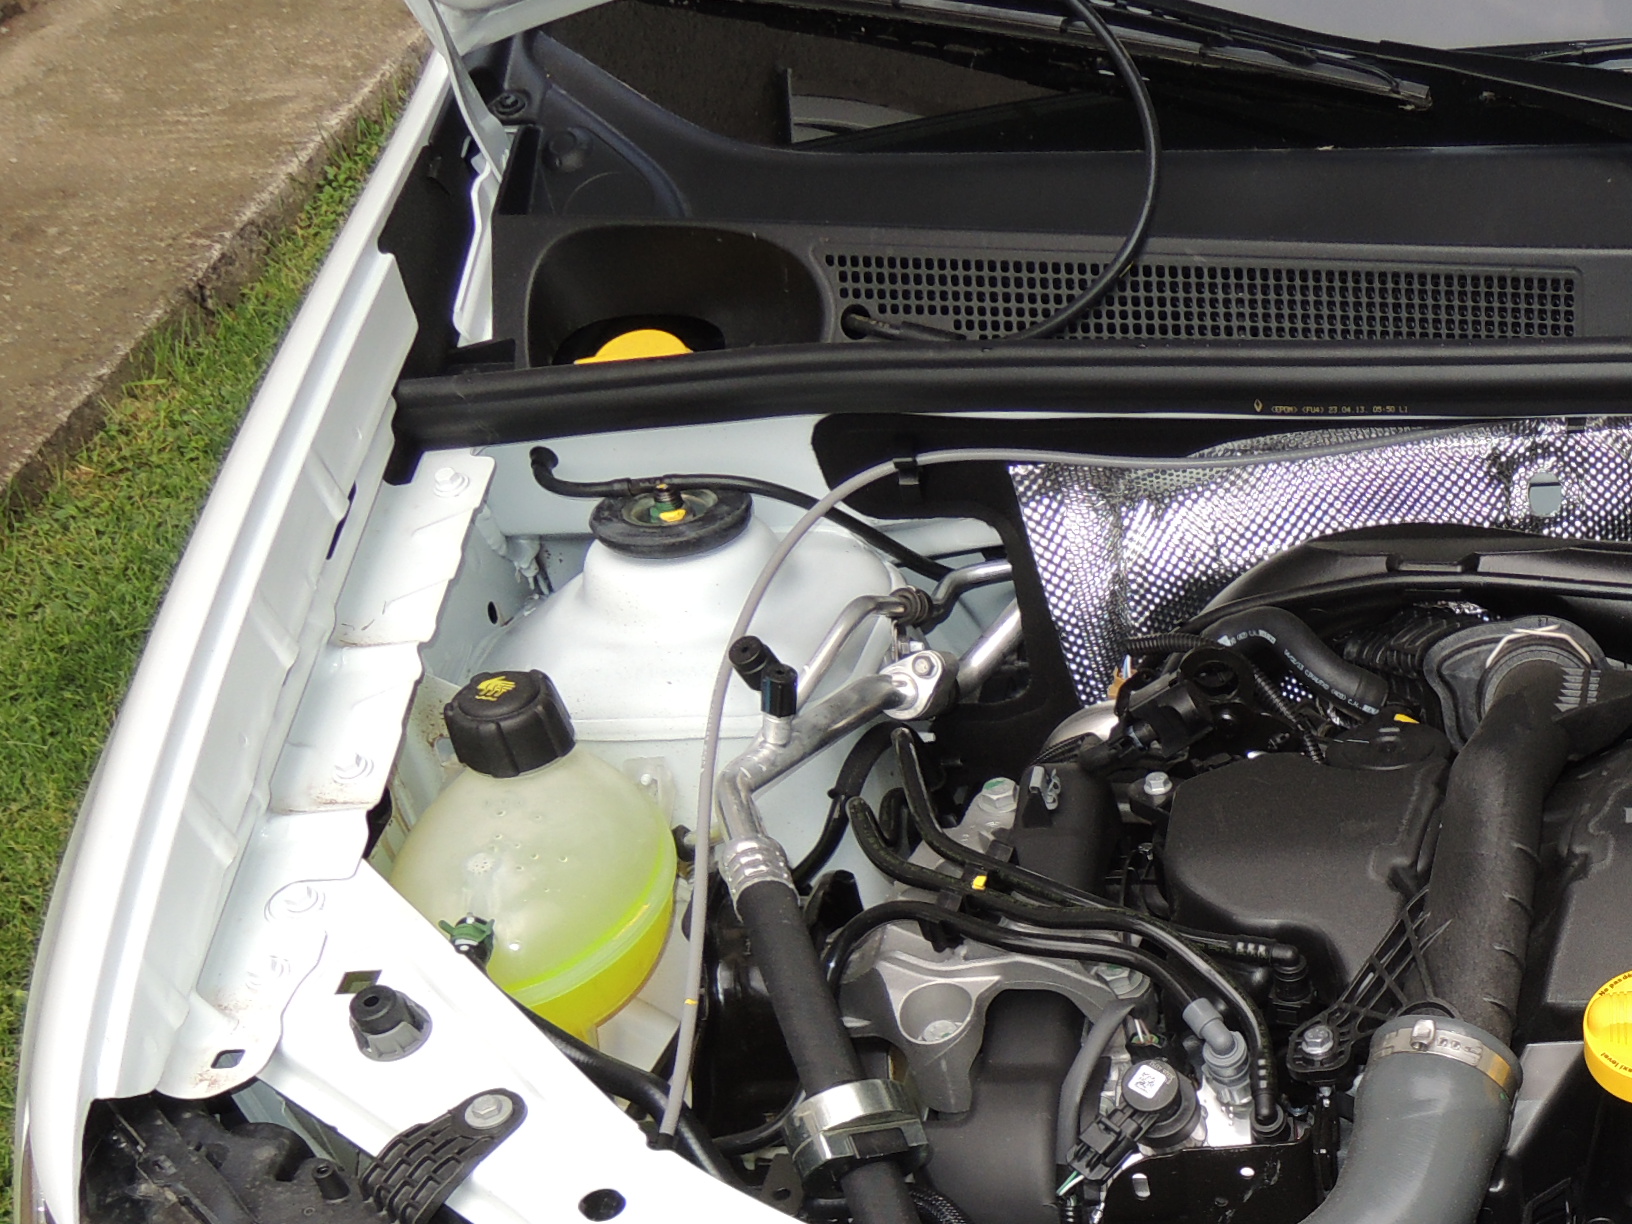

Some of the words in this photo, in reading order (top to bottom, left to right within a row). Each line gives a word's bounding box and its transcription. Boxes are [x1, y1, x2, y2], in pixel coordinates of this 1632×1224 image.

[1599, 986, 1609, 997] Ne
[1609, 978, 1623, 990] pas
[1600, 1052, 1618, 1068] level
